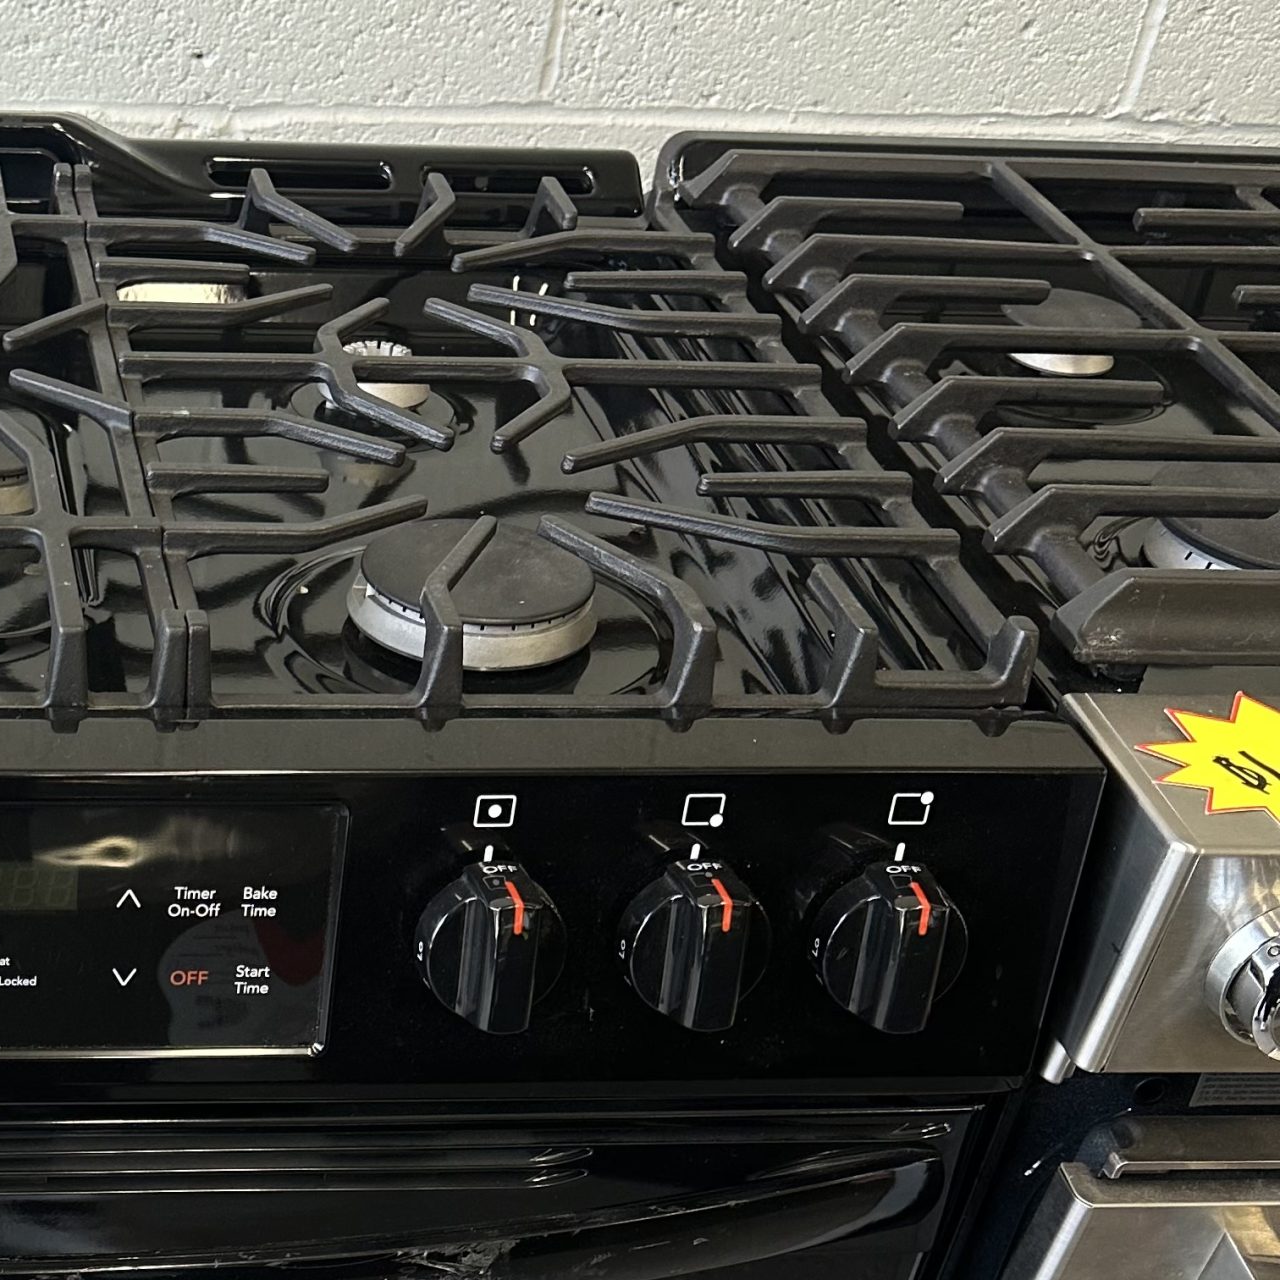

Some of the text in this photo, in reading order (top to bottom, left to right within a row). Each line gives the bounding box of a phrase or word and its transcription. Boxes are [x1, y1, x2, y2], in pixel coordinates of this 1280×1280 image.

[482, 864, 518, 874] OFF
[687, 862, 723, 871] OFF
[886, 865, 922, 873] OFF
[173, 886, 217, 900] Timer
[243, 885, 278, 900] Bake
[167, 902, 221, 918] On-Off
[241, 903, 277, 917] Time
[170, 970, 209, 986] OFF
[235, 964, 271, 978] Start
[233, 981, 270, 995] Time
